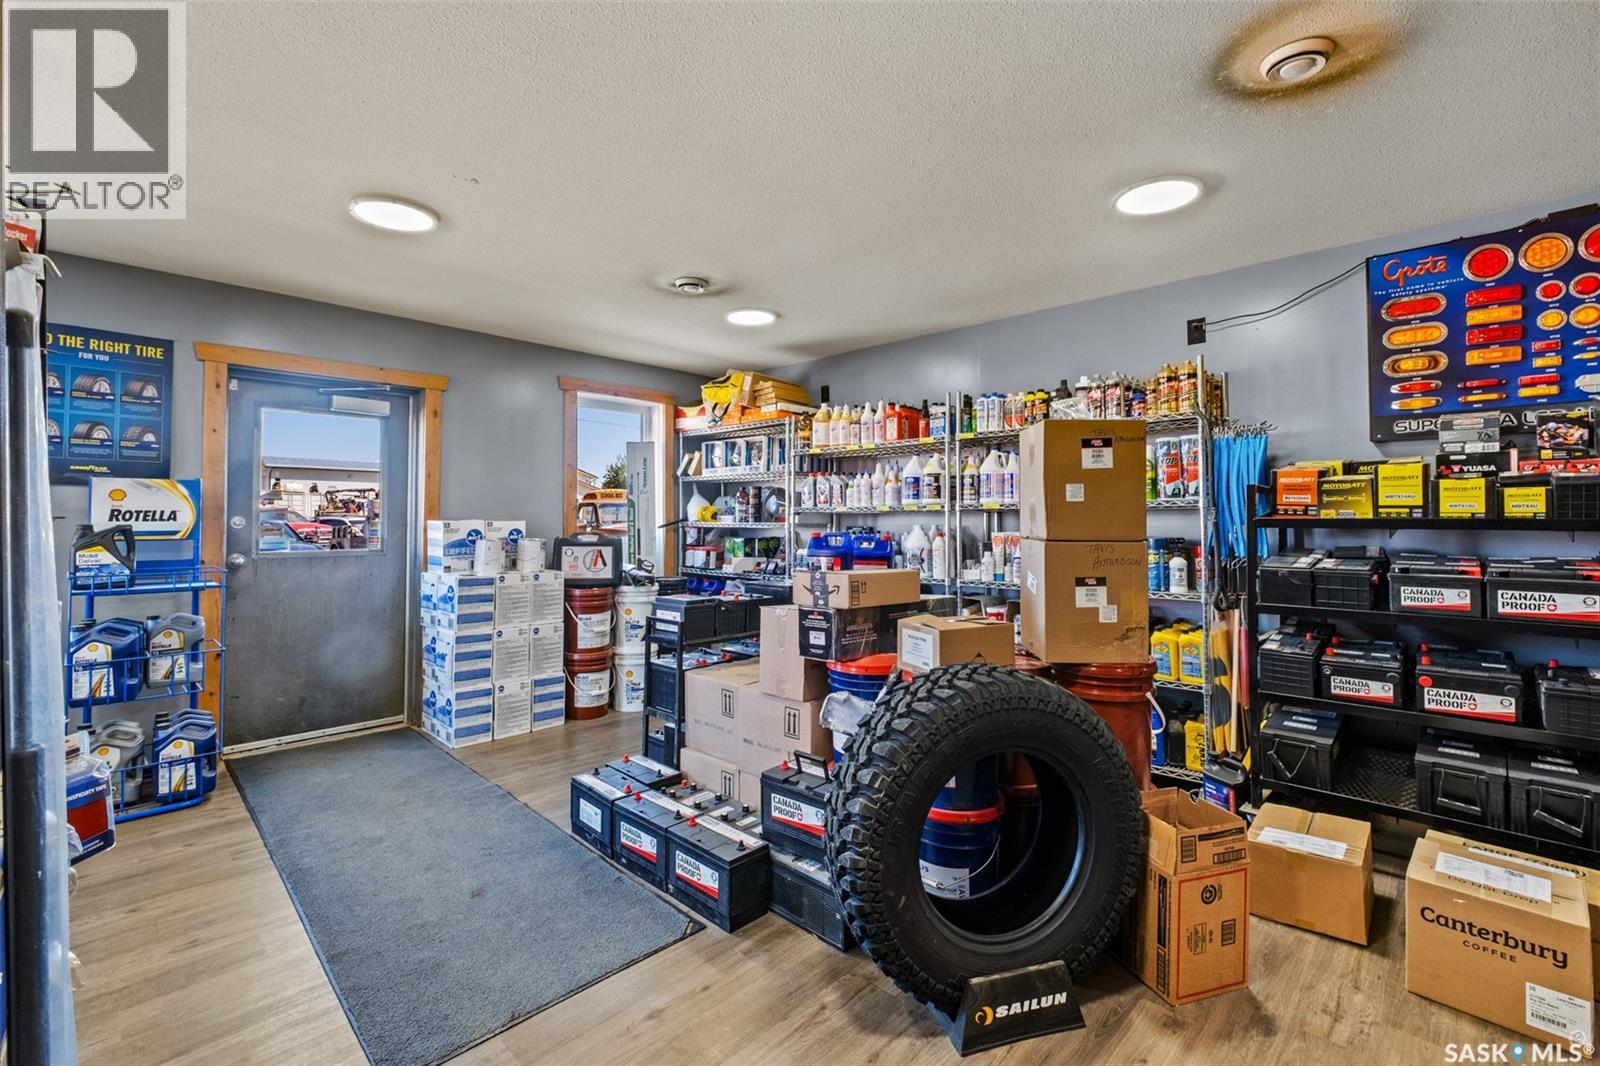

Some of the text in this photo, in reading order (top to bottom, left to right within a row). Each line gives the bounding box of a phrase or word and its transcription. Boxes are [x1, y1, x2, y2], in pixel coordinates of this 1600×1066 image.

[1382, 256, 1447, 287] Grote
[57, 334, 84, 349] THE
[89, 338, 131, 355] RIGHT
[135, 345, 165, 360] TIRE
[79, 352, 93, 360] FOR
[1462, 464, 1497, 472] YUASA
[108, 508, 178, 522] ROTELLA
[1402, 588, 1445, 597] CANADA
[1403, 595, 1436, 604] PROOF
[1500, 591, 1557, 603] CANADA
[1501, 601, 1546, 612] PROOF
[1332, 677, 1370, 689] CANADA
[1333, 684, 1363, 694] PROOF
[1426, 688, 1478, 703] CANADA
[1427, 697, 1467, 710] PROOF
[773, 796, 802, 812] CANADA
[773, 805, 797, 820] PROOF
[622, 823, 642, 839] CANADA
[622, 832, 639, 846] PROOF
[677, 853, 702, 873] CANADA
[677, 863, 697, 881] PROOF
[1420, 906, 1568, 969] Canterbury
[1463, 940, 1517, 963] COFFEE
[995, 991, 1068, 1018] SAILUN
